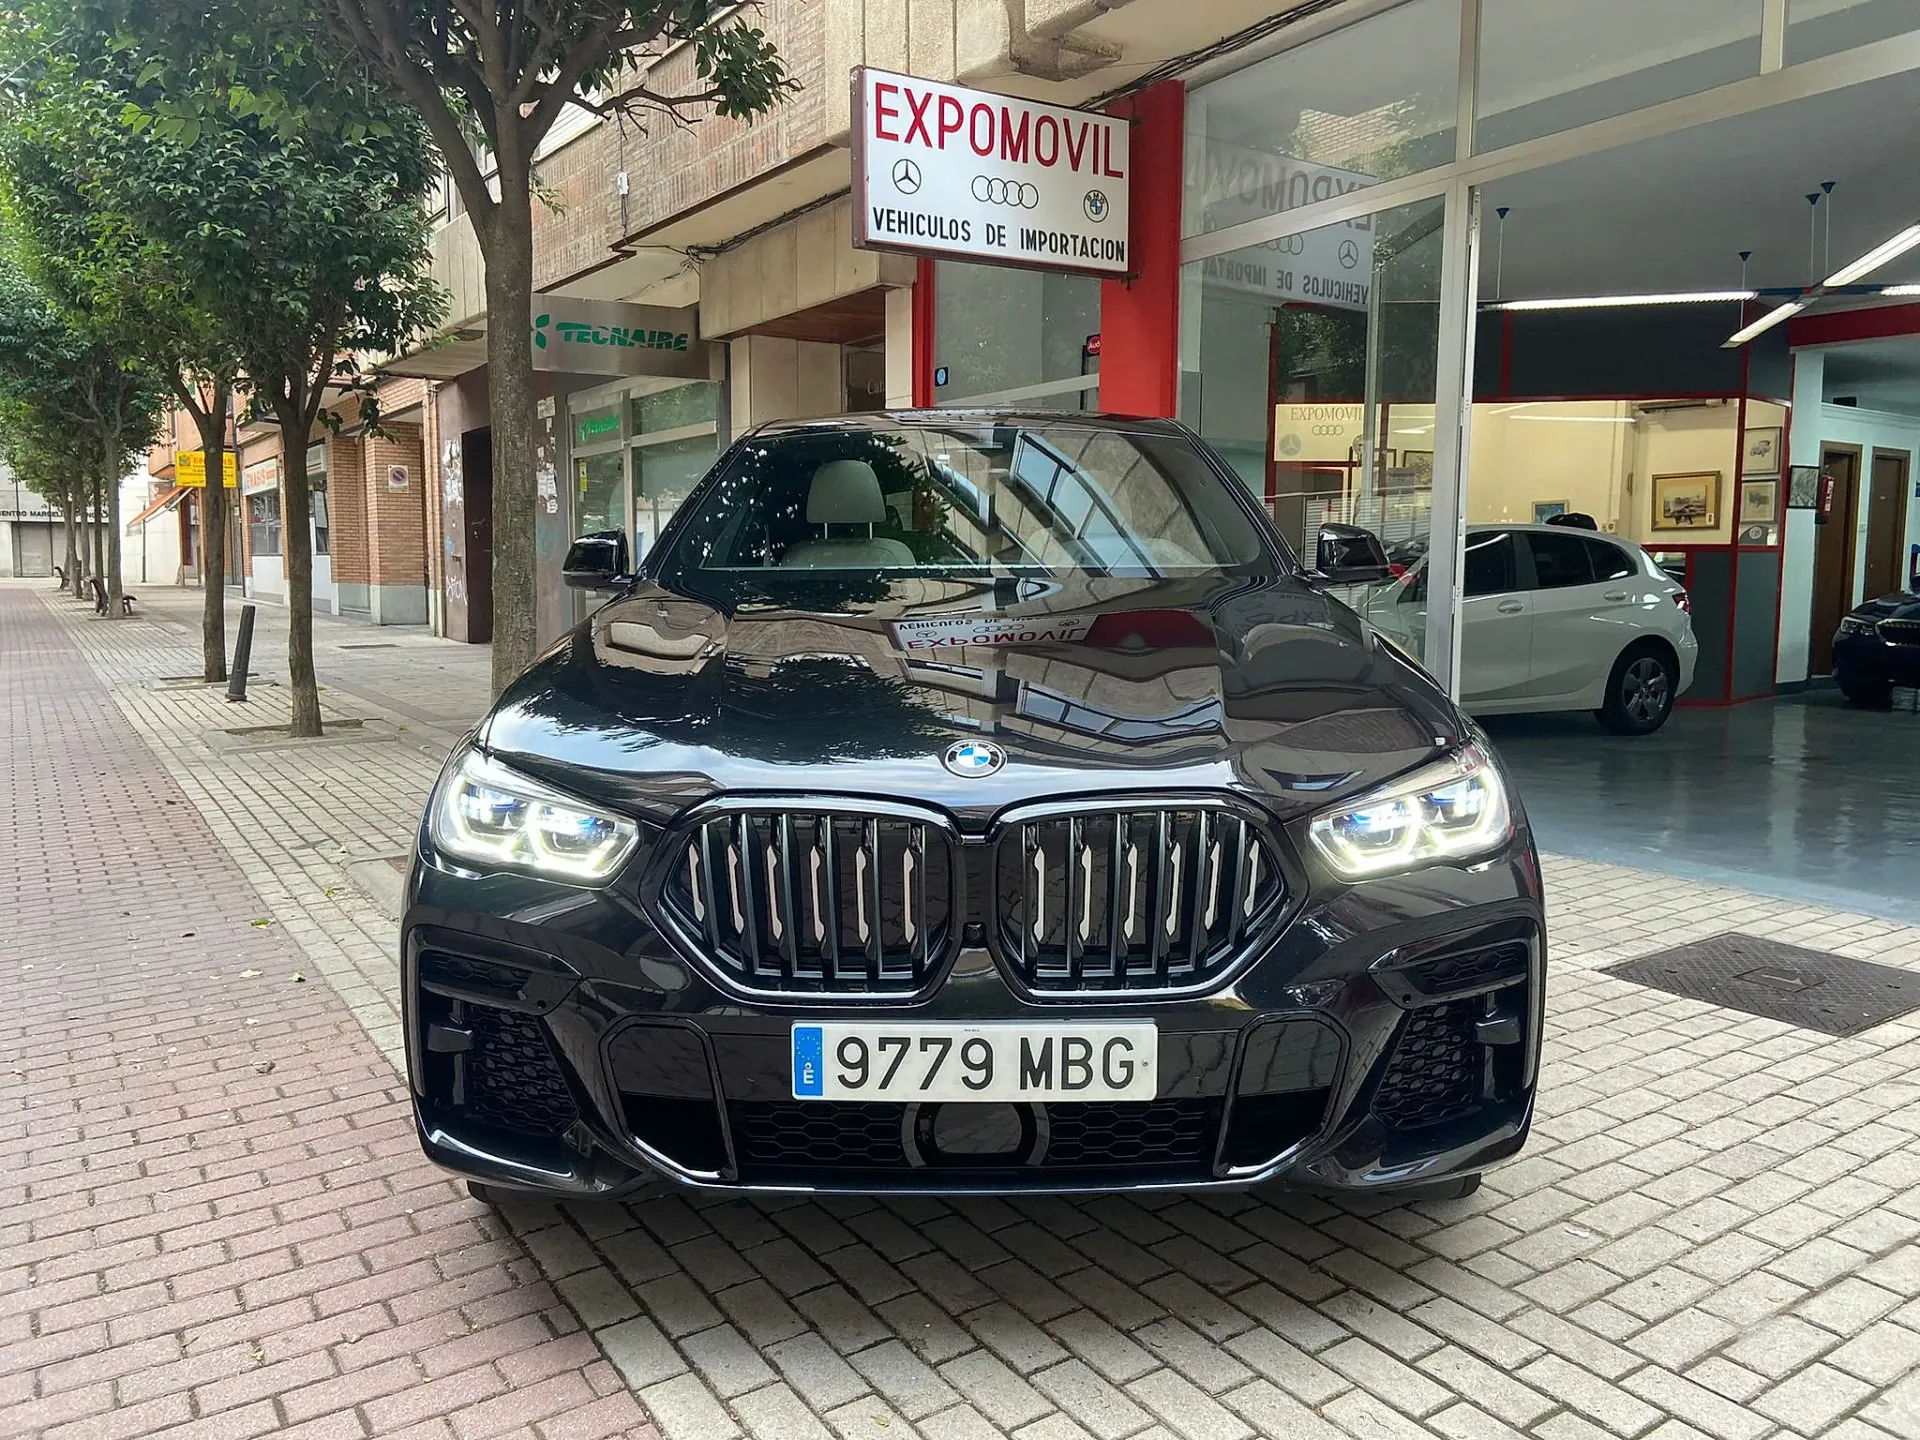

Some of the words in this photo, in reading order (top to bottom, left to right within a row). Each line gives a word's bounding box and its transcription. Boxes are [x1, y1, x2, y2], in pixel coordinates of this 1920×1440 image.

[874, 81, 1124, 179] EXPOMOVIL
[872, 206, 971, 242] VEHICULOS
[985, 223, 1007, 248] DE
[1020, 228, 1125, 262] IMPORTACION
[556, 321, 688, 352] TECNAIRE
[835, 1035, 994, 1091] 9779
[1018, 1036, 1135, 1091] MBG
